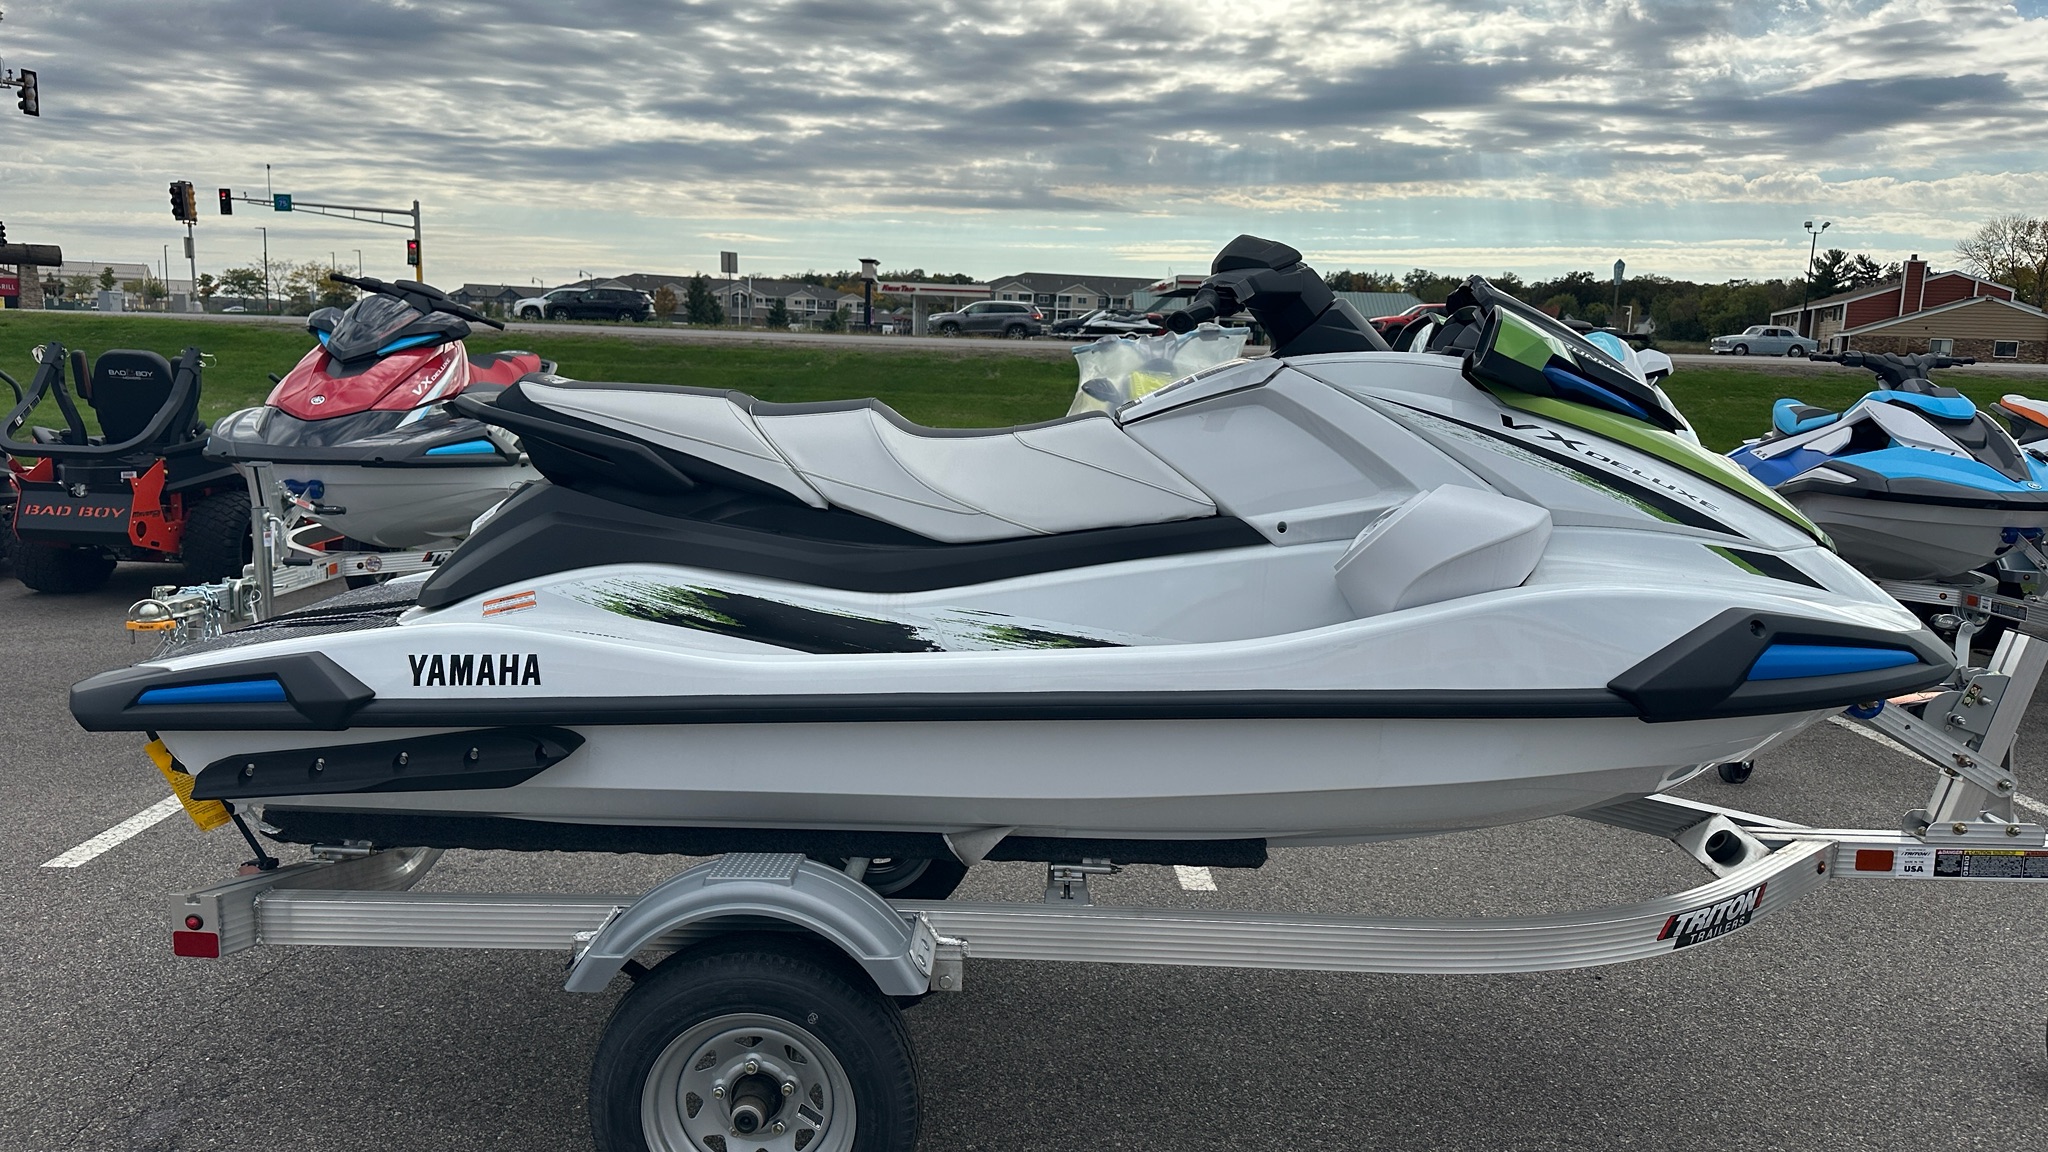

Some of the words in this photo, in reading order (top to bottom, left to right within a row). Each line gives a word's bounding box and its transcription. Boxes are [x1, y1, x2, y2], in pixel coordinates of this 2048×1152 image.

[411, 375, 433, 396] VX
[430, 357, 452, 382] DELUXE
[1500, 413, 1590, 452] VX
[1585, 450, 1720, 512] DELUXE
[24, 504, 73, 516] BAD
[78, 506, 126, 518] BOY
[408, 653, 541, 687] YAMAHA
[1673, 887, 1761, 937] TRITON
[1689, 916, 1746, 945] TRAILERS
